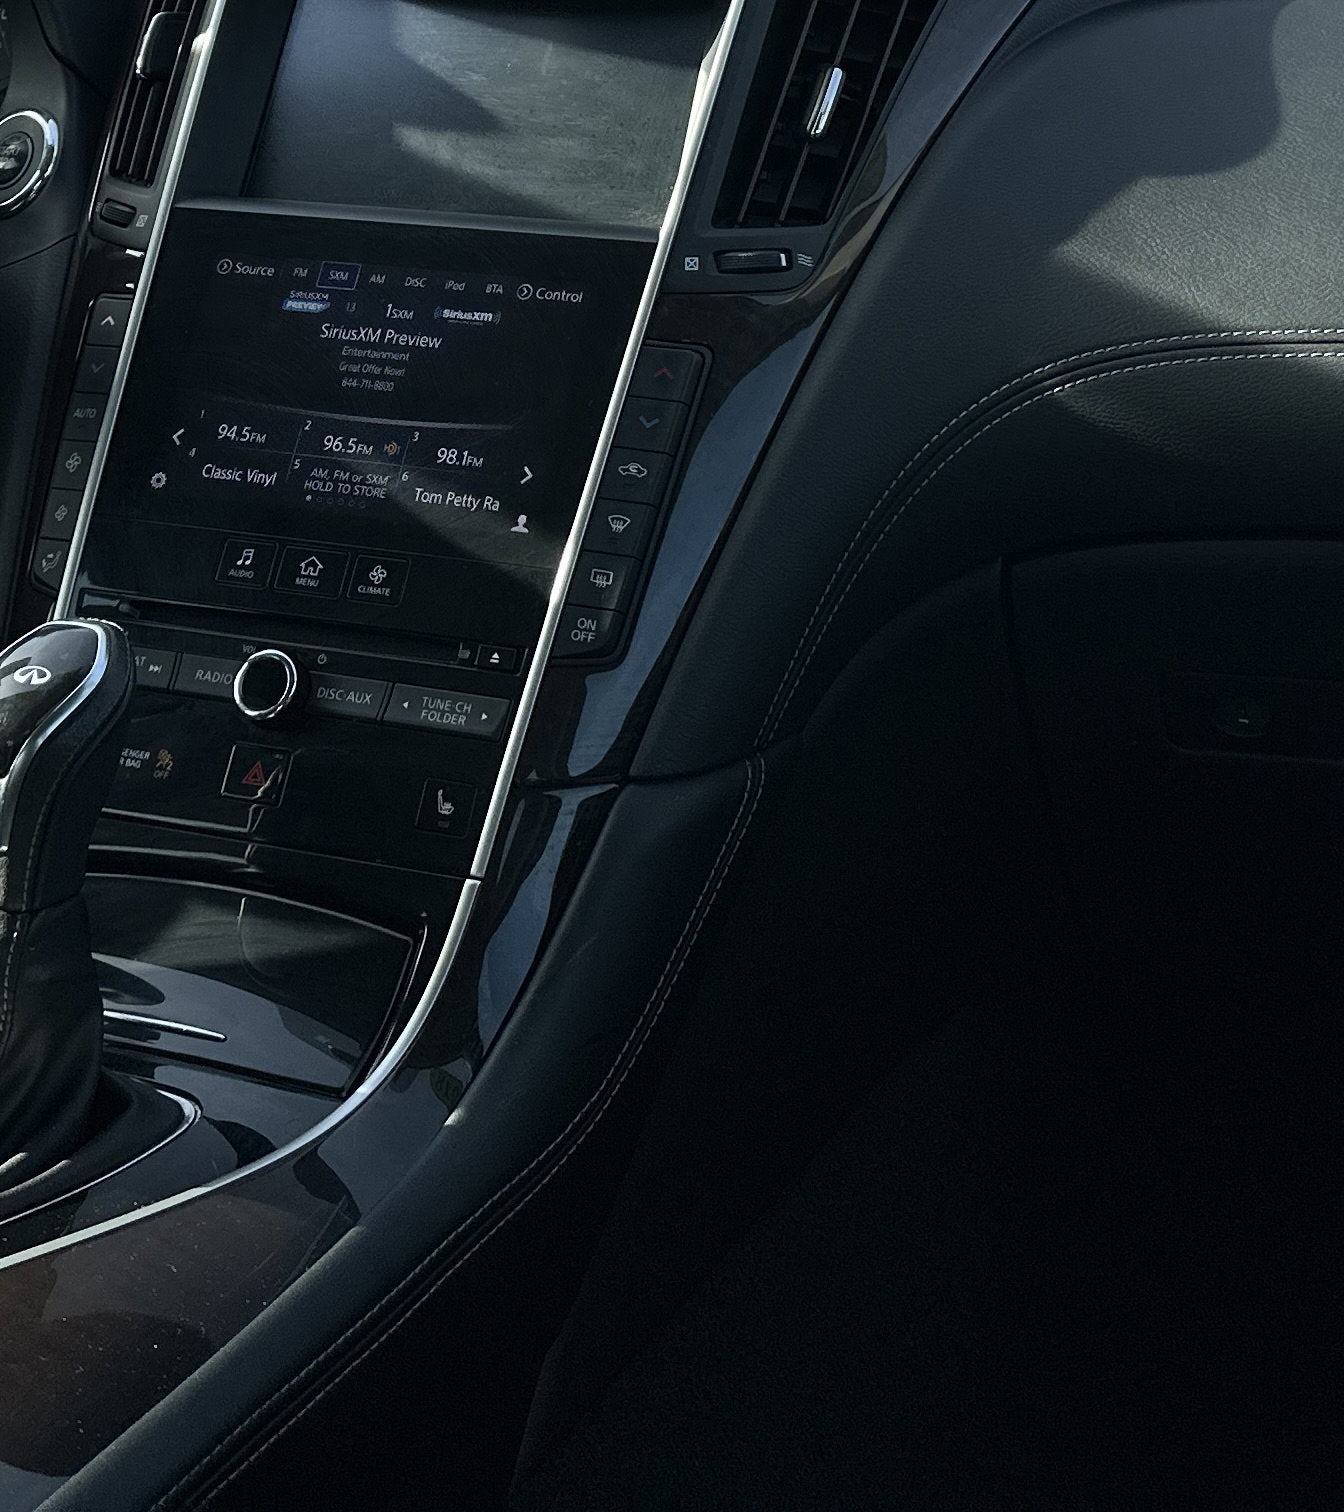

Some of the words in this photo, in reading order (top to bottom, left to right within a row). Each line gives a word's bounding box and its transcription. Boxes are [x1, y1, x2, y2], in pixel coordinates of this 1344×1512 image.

[234, 262, 275, 277] Source
[293, 267, 309, 278] FM
[328, 270, 349, 281] SXM
[369, 274, 386, 285] AM
[445, 280, 467, 292] iPod
[485, 283, 505, 295] BTA
[536, 287, 584, 304] Control
[320, 323, 381, 344] SiriusXM
[384, 329, 443, 349] Preview
[342, 346, 410, 362] Entertainment
[73, 408, 97, 419] AUTO
[303, 420, 312, 431] 2
[411, 431, 420, 442] 3
[293, 459, 302, 470] 5
[201, 463, 244, 482] Classic
[246, 468, 278, 488] Vinyl
[333, 470, 350, 481] FM
[352, 473, 363, 483] or
[365, 474, 390, 486] SXM
[401, 472, 409, 482] 6
[303, 480, 333, 493] HOLD
[337, 483, 351, 495] TO
[353, 484, 388, 499] STORE
[414, 487, 442, 505] Tom
[446, 491, 481, 512] Petty
[482, 495, 501, 512] Ra
[228, 568, 254, 579] AUDIO
[295, 576, 320, 587] MENU
[357, 584, 391, 597] CLIMATE
[577, 617, 597, 631] ON
[570, 629, 597, 643] OFF
[194, 669, 233, 685] RADIO
[420, 709, 467, 726] FOLDER
